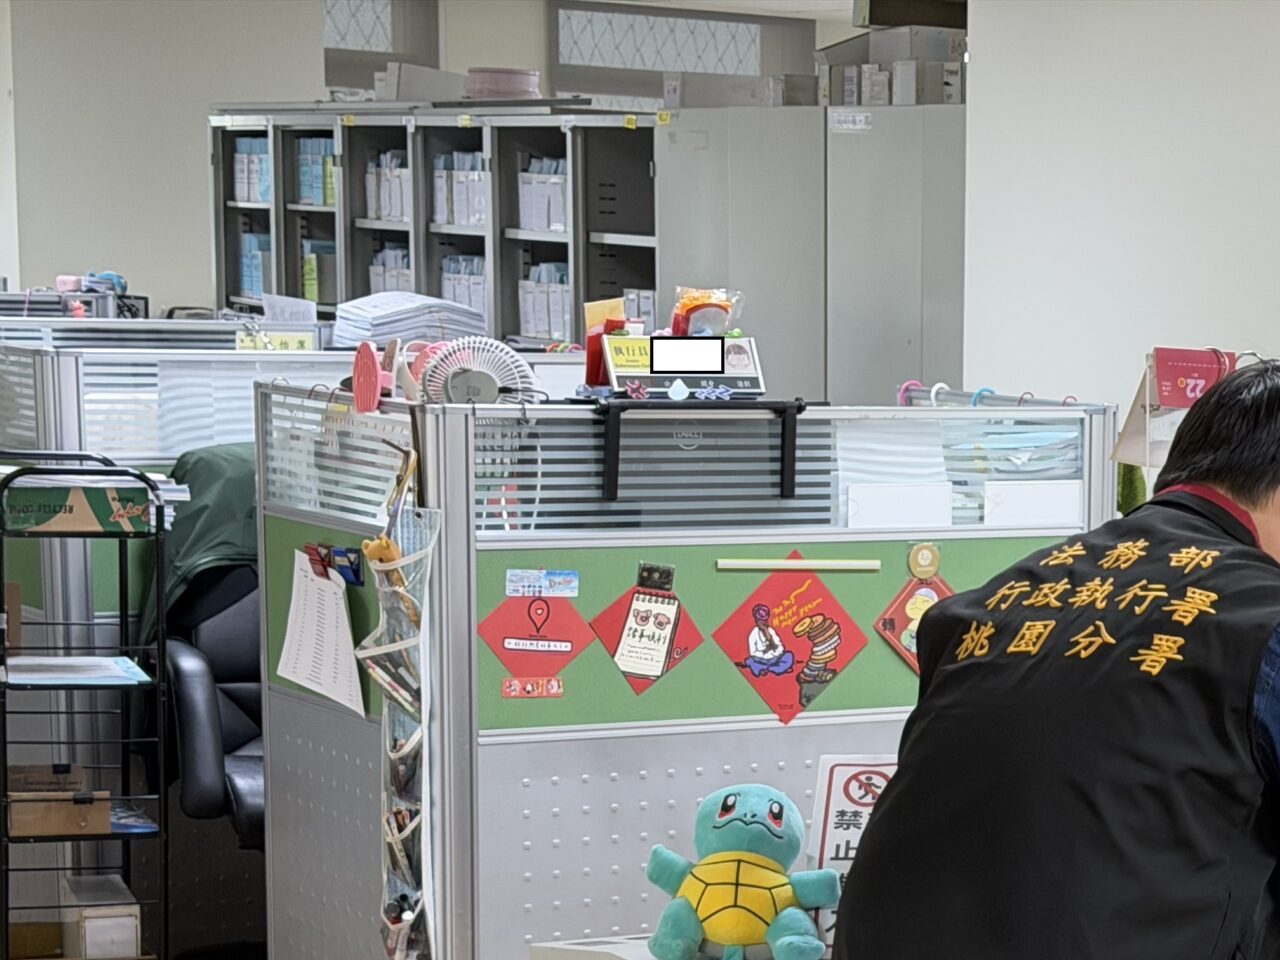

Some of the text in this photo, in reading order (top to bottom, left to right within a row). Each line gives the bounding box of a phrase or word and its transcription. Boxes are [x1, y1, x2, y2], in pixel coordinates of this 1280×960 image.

[1039, 537, 1222, 575] 法務部
[985, 576, 1220, 628] 行政執行署
[955, 619, 1187, 677] 桃園分署
